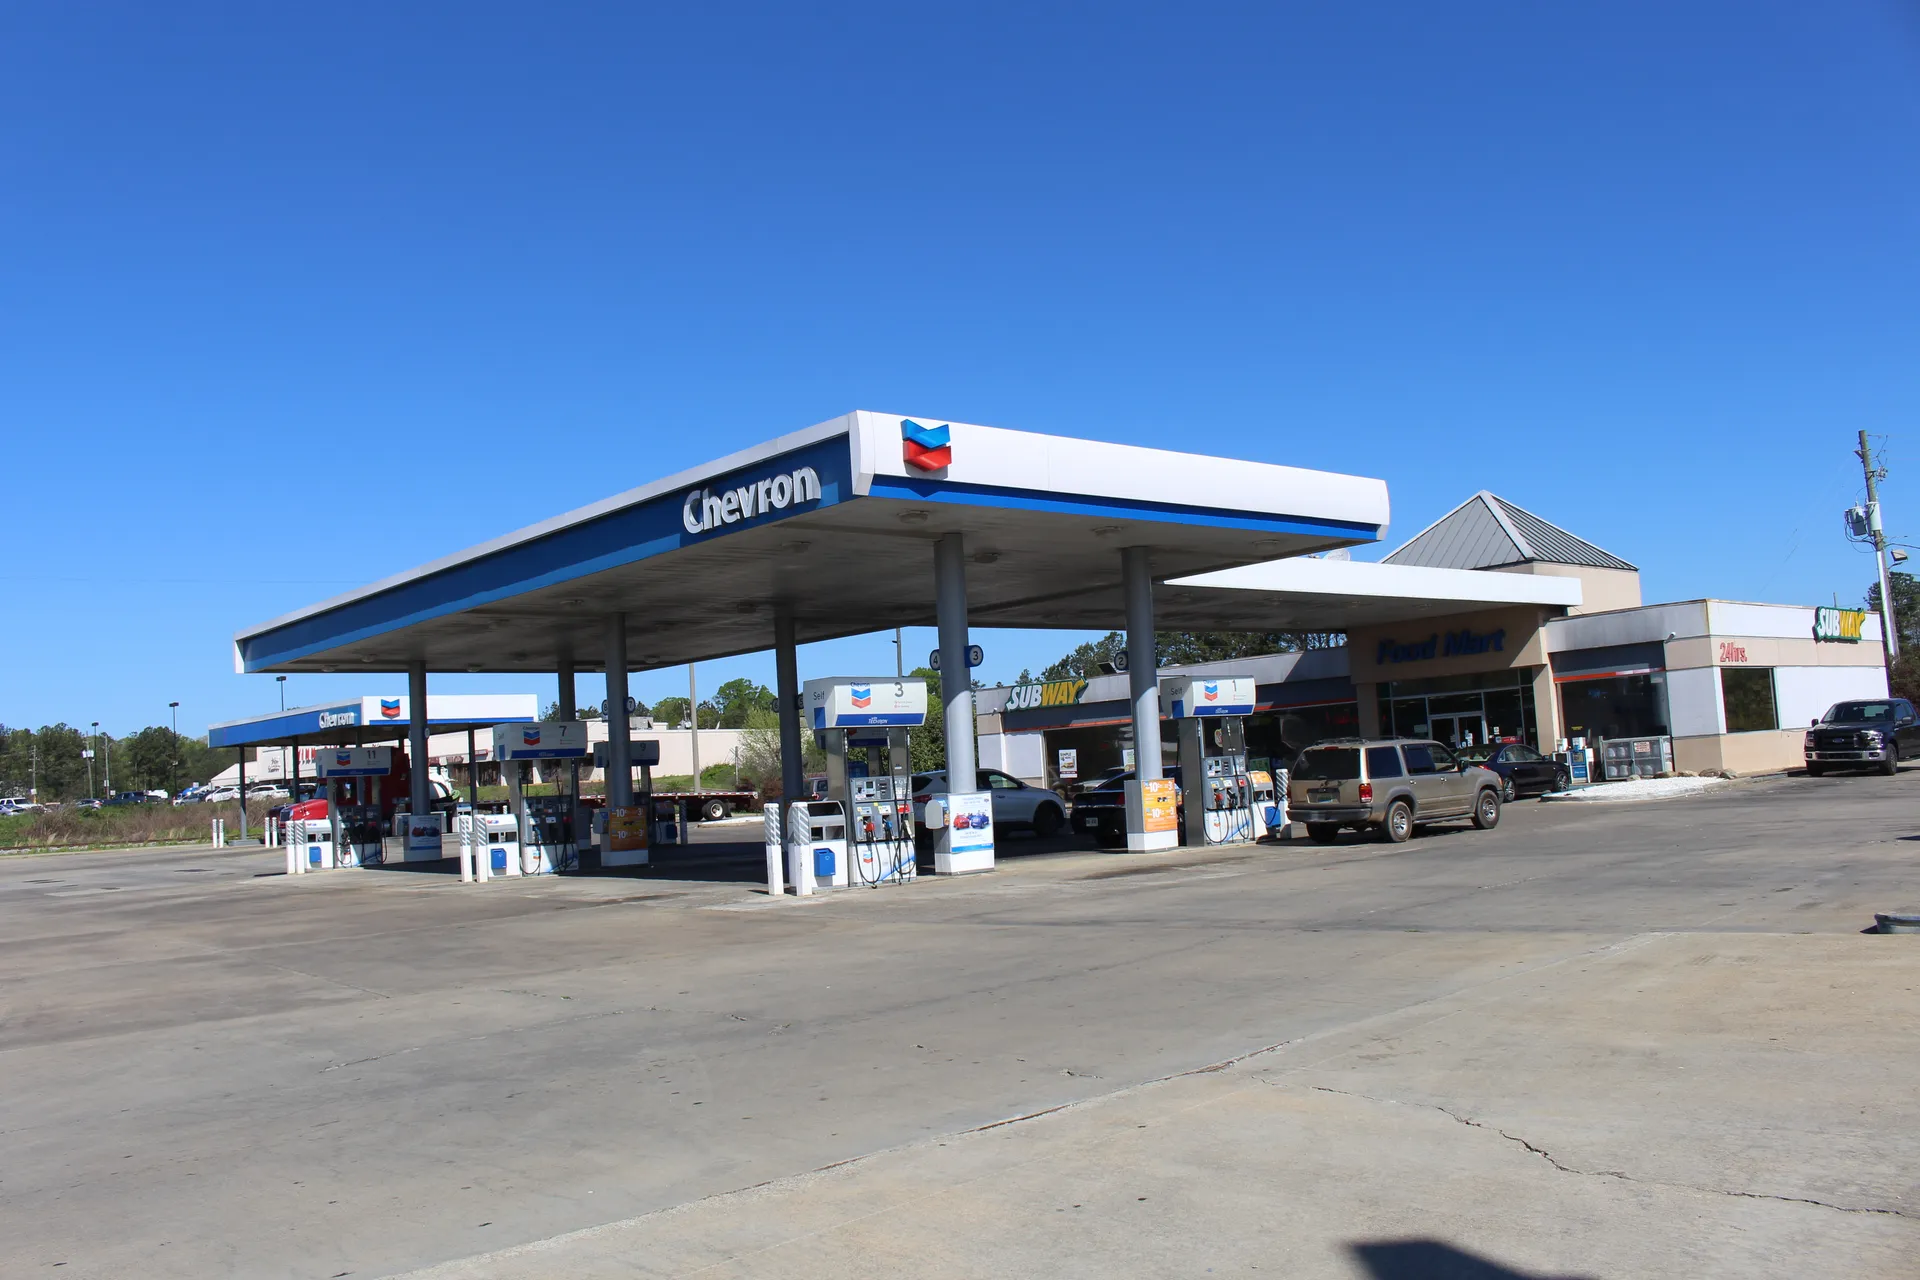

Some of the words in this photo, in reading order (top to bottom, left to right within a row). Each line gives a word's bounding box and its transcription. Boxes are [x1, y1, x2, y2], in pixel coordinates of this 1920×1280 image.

[682, 466, 822, 534] Chevron
[1816, 607, 1865, 638] SUBWAY
[1376, 632, 1439, 665] Food
[1442, 628, 1506, 657] Mart
[932, 655, 939, 665] 4
[972, 650, 979, 661] 3
[1118, 656, 1125, 666] 2
[813, 690, 825, 700] Self
[894, 681, 904, 698] 3
[1006, 678, 1085, 711] SUBWAY
[1170, 687, 1184, 696] Self
[319, 711, 355, 729] Chevron
[558, 725, 568, 737] 7
[640, 742, 647, 752] 9
[367, 750, 376, 760] 11
